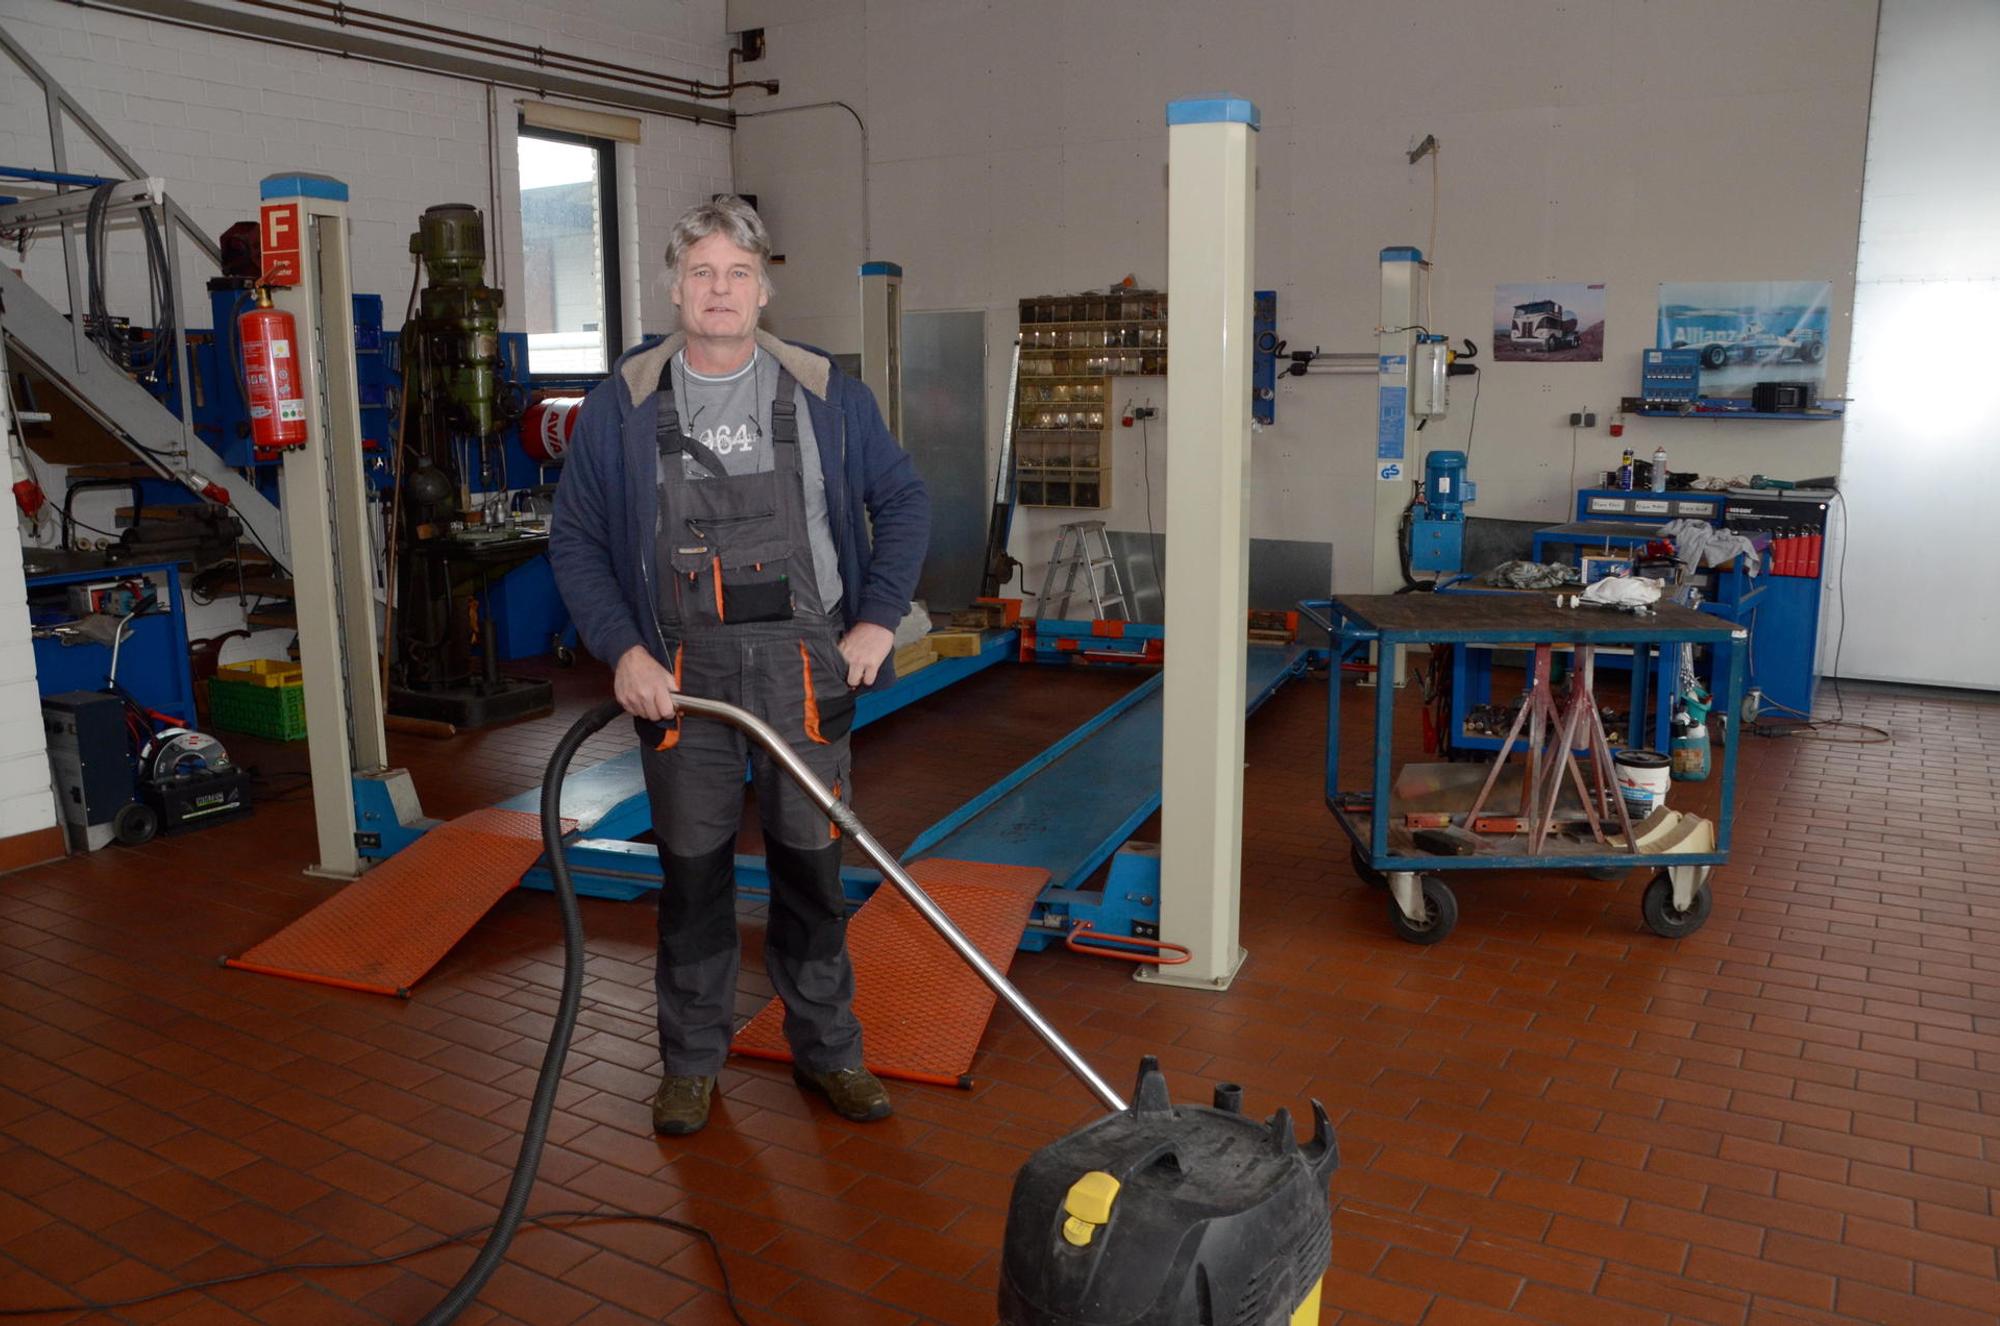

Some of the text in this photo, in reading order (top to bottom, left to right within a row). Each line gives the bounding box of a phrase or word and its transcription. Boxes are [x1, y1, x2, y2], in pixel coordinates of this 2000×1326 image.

[269, 209, 290, 248] F
[1674, 327, 1740, 345] Allianz
[547, 410, 563, 454] AVIA
[1380, 464, 1400, 480] GS
